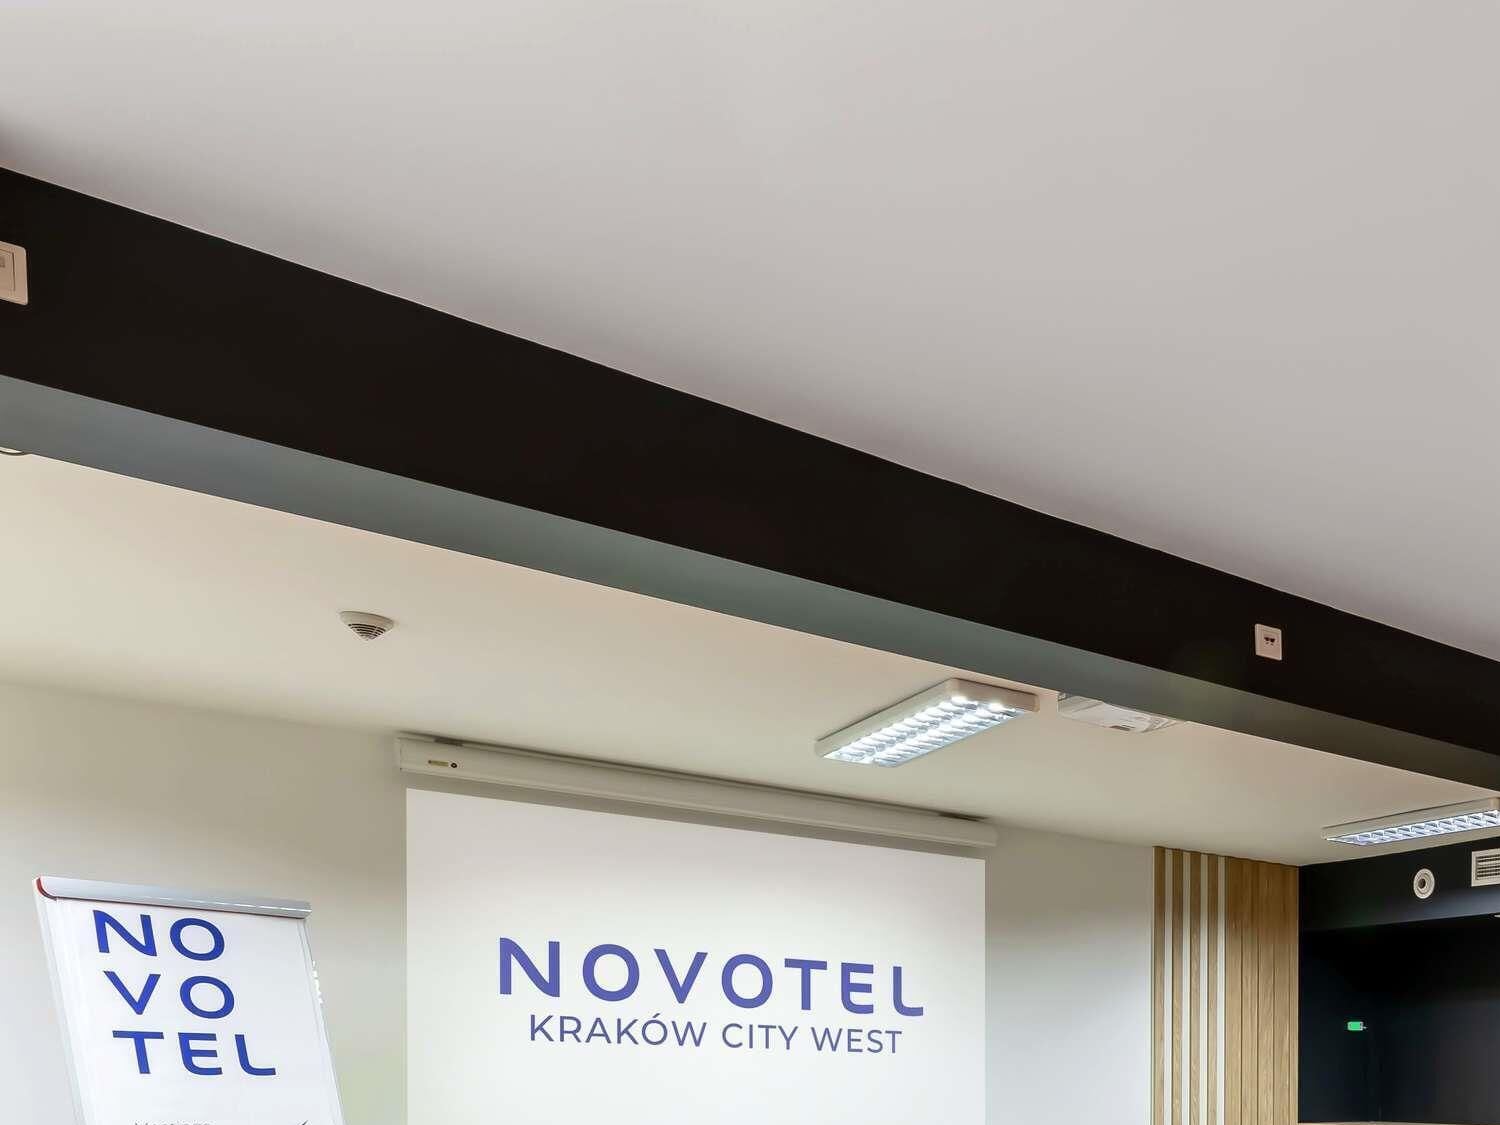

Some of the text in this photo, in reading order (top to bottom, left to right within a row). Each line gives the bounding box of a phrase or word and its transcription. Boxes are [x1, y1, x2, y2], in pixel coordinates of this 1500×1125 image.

[94, 910, 225, 961] NO
[104, 970, 235, 1019] VO
[499, 937, 924, 1017] NOVOTEL
[112, 1030, 277, 1076] TEL
[529, 1013, 903, 1054] KRAKÓW CITY WEST
